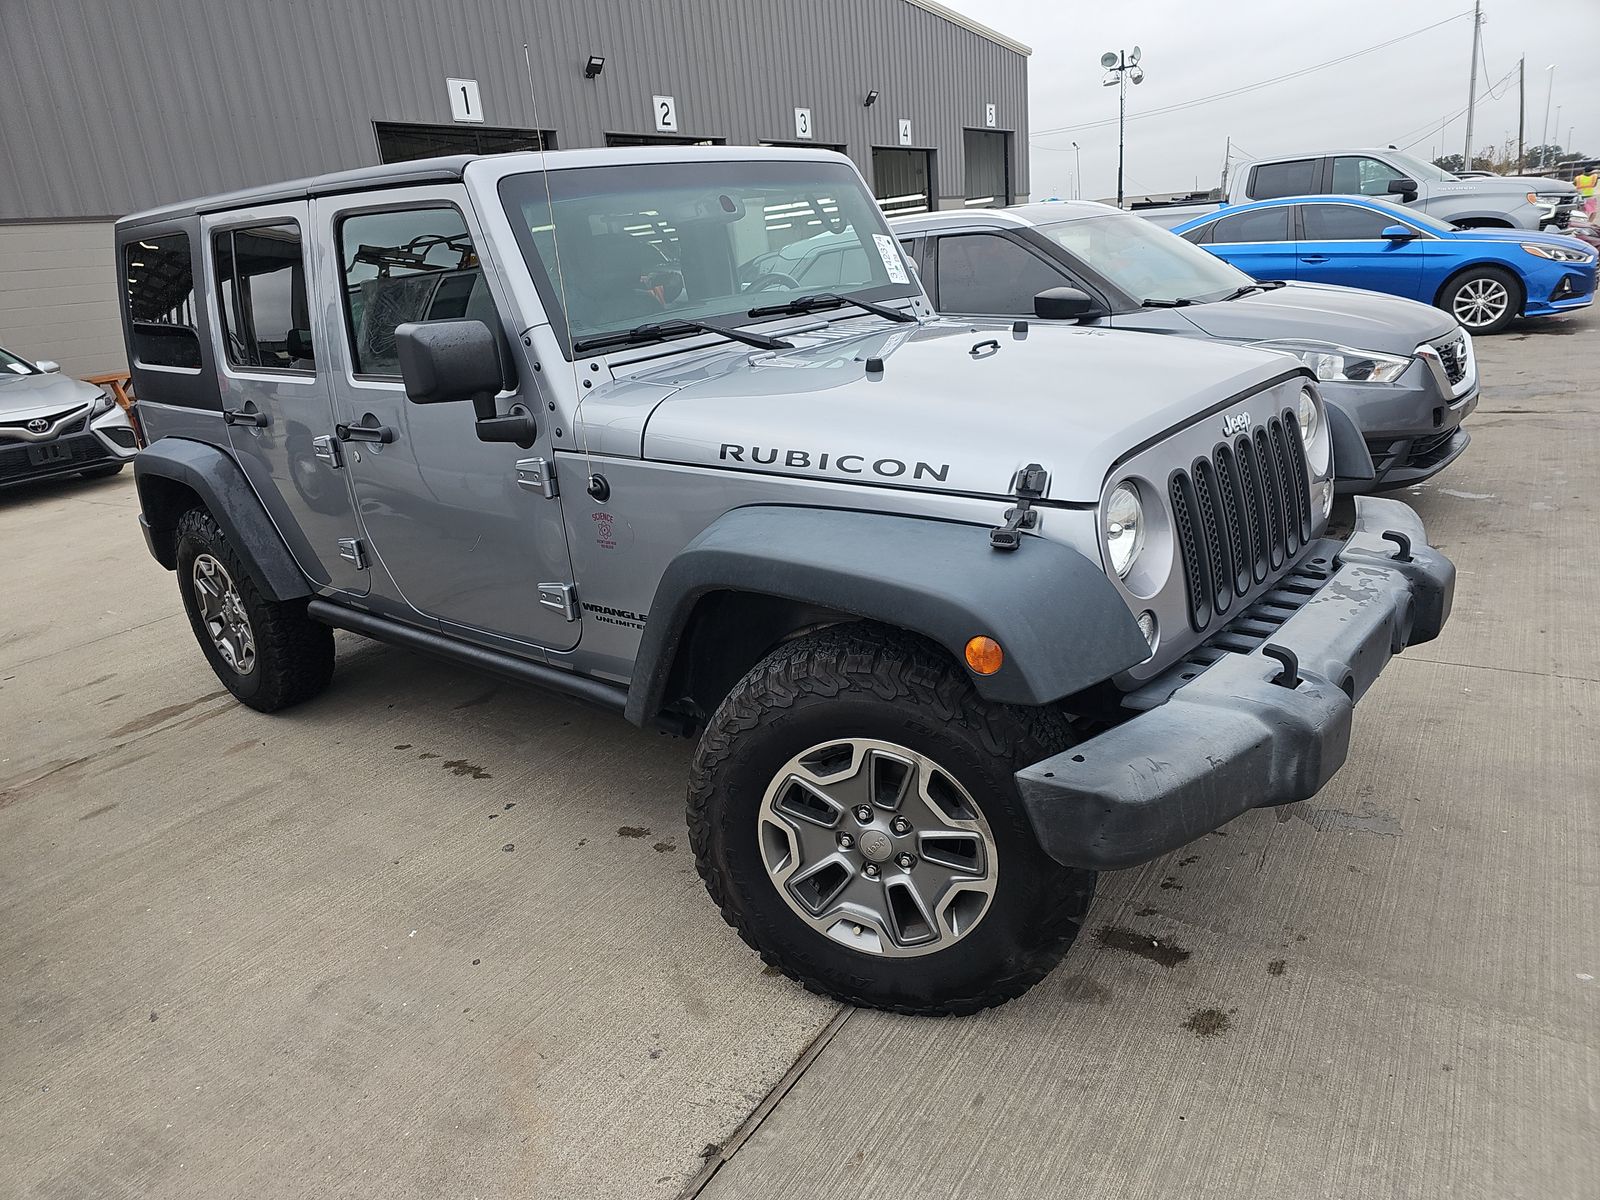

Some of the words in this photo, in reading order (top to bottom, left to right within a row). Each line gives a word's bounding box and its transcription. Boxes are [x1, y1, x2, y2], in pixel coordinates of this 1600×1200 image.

[461, 86, 470, 115] 1
[660, 102, 672, 126] 2
[800, 113, 808, 133] 3
[988, 107, 994, 123] 5
[903, 124, 909, 143] 4
[1222, 411, 1251, 437] Jeep
[719, 443, 950, 482] RUBICON
[591, 511, 614, 524] SCIENCE
[582, 602, 648, 622] WRANGLE
[866, 837, 886, 855] Jeep
